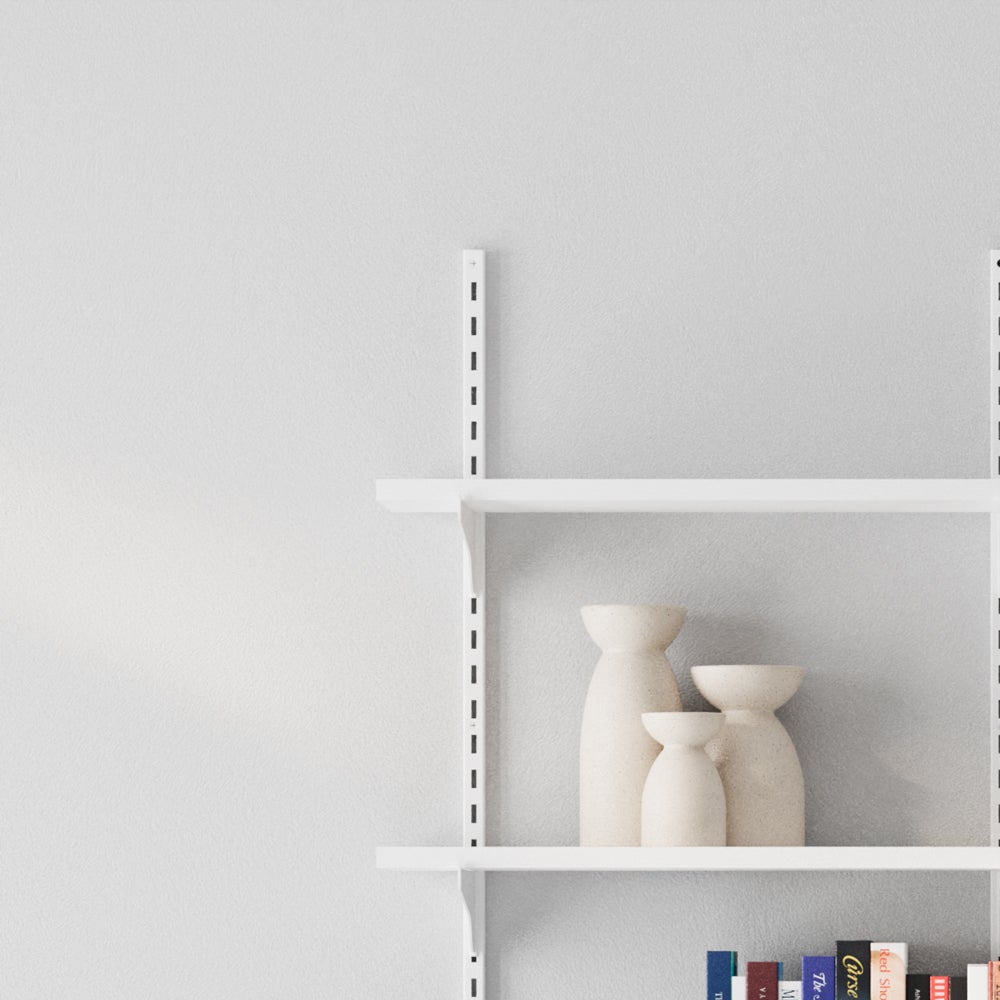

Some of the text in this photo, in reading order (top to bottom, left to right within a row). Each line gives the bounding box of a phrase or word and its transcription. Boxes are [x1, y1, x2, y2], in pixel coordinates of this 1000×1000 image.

[879, 949, 890, 972] Red
[813, 972, 826, 992] The
[842, 955, 864, 999] Curse
